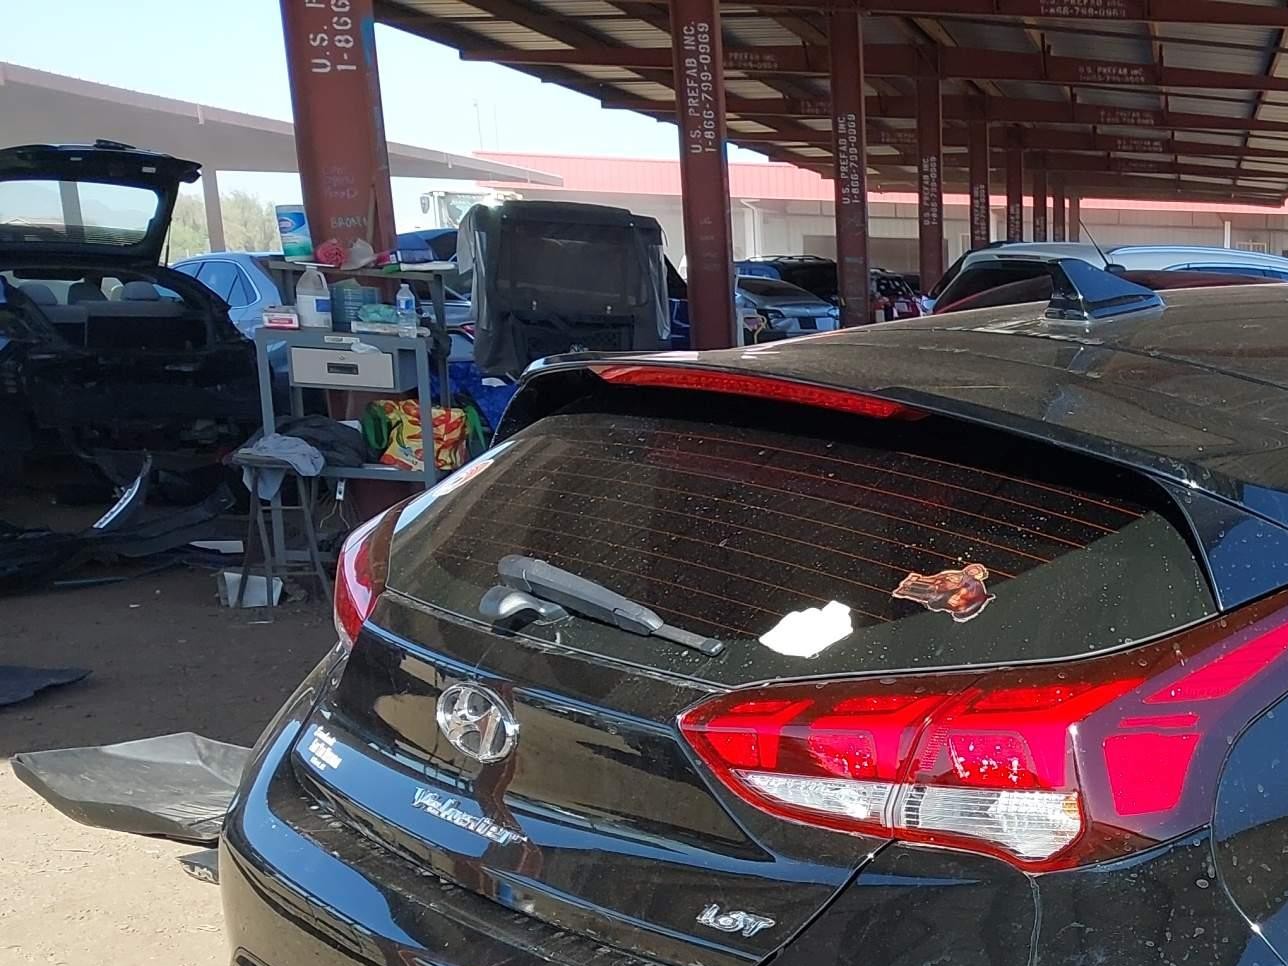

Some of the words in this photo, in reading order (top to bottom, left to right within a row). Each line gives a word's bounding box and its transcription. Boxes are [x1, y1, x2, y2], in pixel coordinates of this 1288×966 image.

[309, 25, 332, 73] U.S.
[682, 21, 697, 52] INC.
[685, 58, 702, 118] PREFAB
[697, 22, 717, 153] 1-866-799-0969
[689, 126, 703, 154] U.S.
[838, 137, 849, 179] PREFAB
[846, 113, 861, 204] 1-866-799-0969
